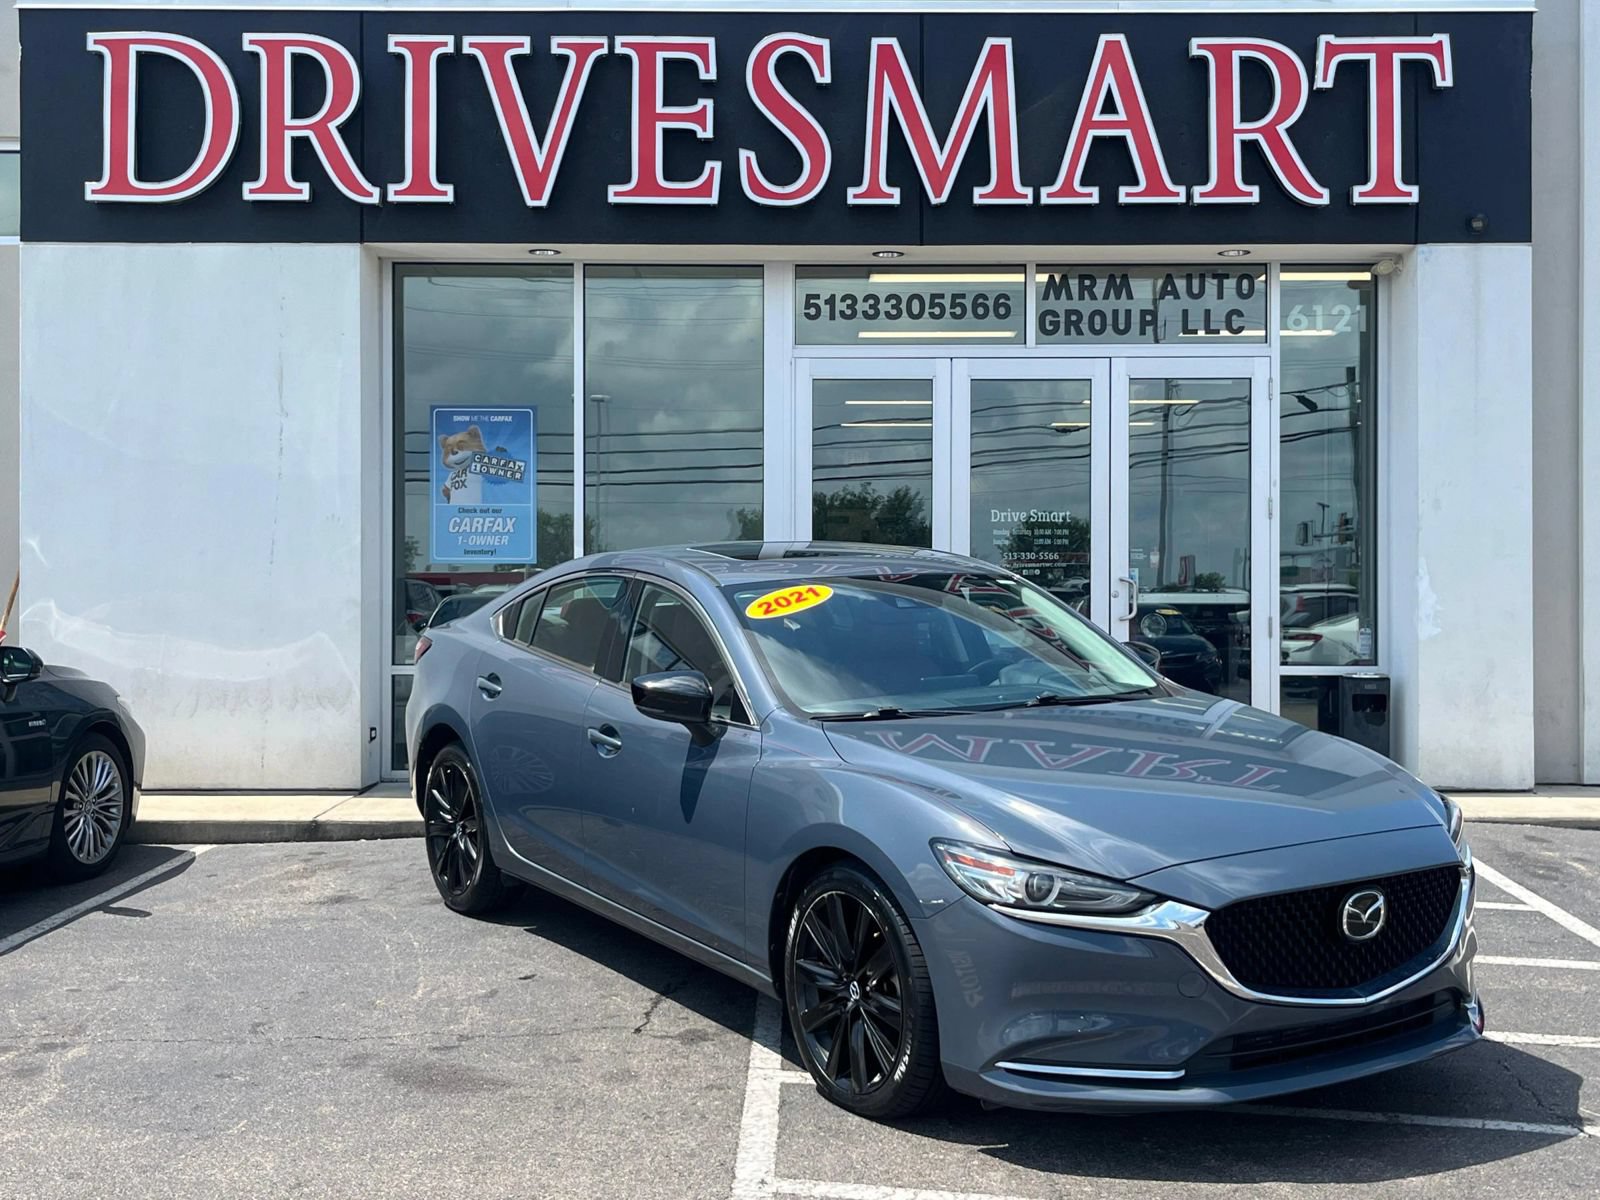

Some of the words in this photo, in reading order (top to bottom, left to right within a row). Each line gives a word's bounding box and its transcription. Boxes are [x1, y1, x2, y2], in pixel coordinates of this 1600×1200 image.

[83, 30, 1454, 207] DRIVESMART
[1041, 272, 1136, 302] MRM
[1158, 270, 1257, 301] AUTO
[802, 292, 1012, 321] 5133305566
[1038, 306, 1158, 337] GROUP
[1181, 306, 1247, 336] LLC
[1286, 304, 1367, 333] 6121
[474, 454, 525, 471] CARFAX
[481, 465, 523, 480] OWNER
[451, 479, 468, 490] FOX
[448, 516, 517, 533] CARFAX
[991, 508, 1027, 522] Drive
[1030, 509, 1071, 522] Smart
[1003, 552, 1060, 560] 513-330-5566
[757, 587, 821, 615] 2021
